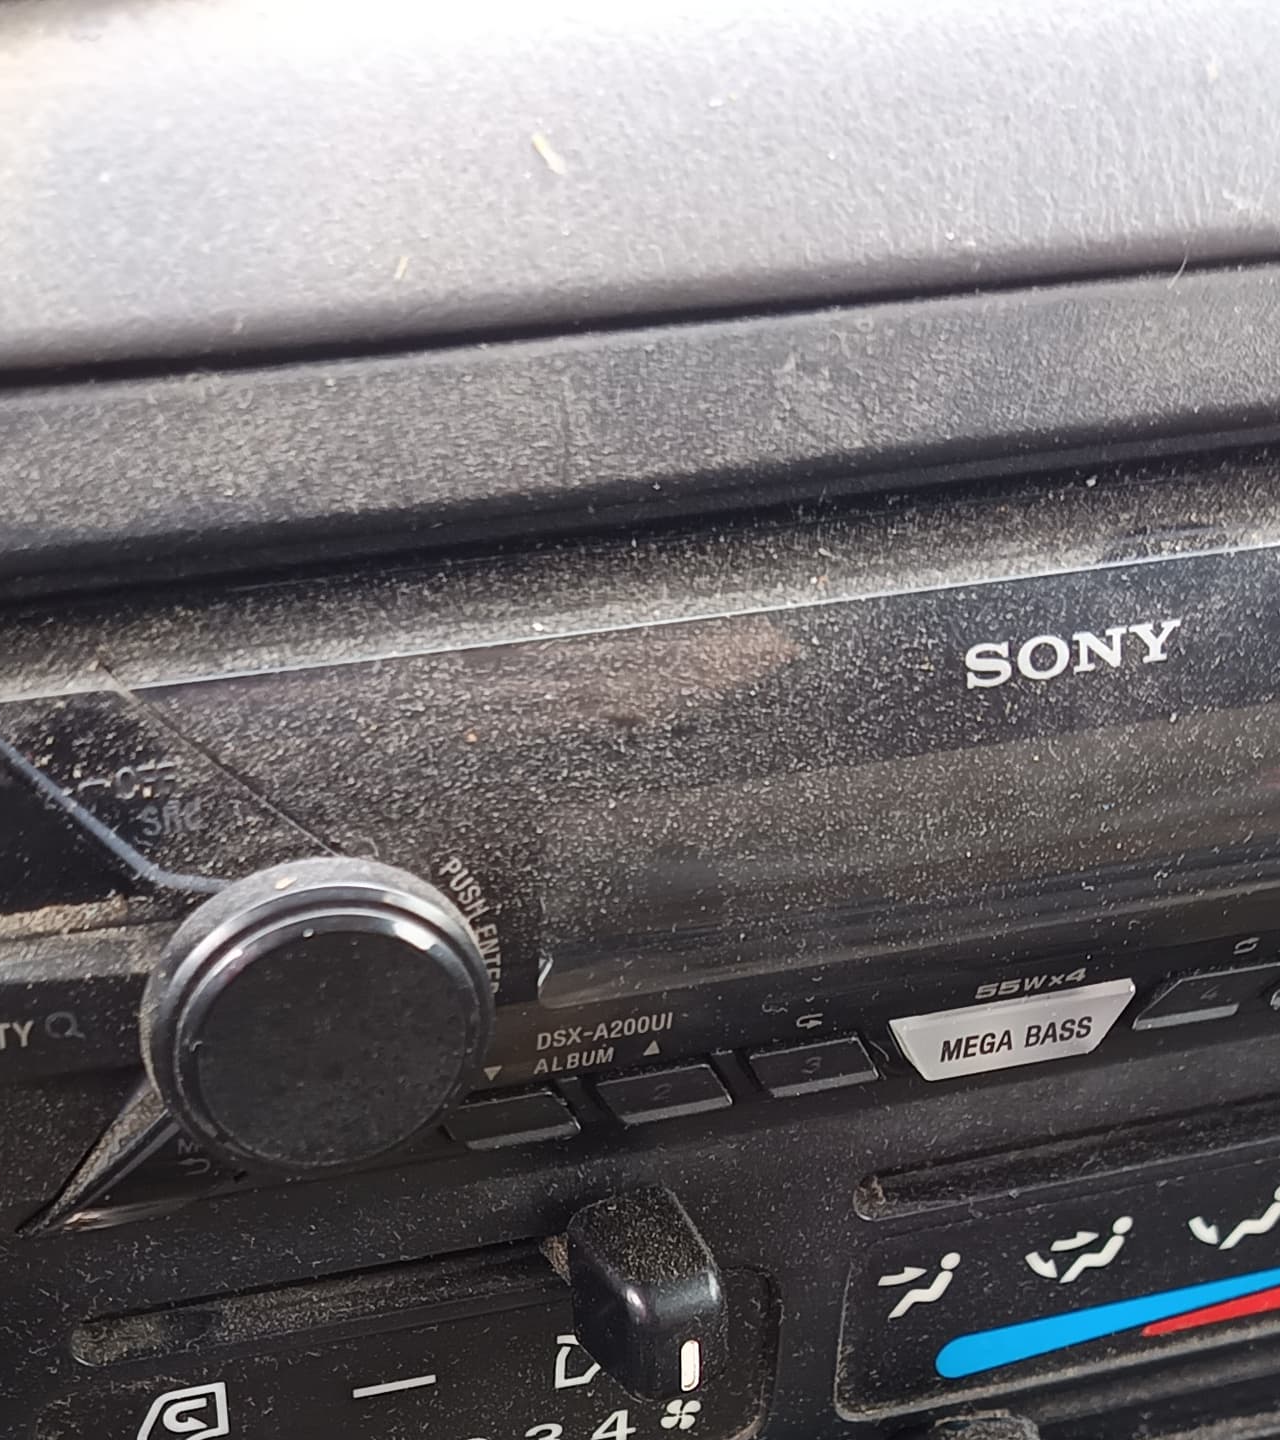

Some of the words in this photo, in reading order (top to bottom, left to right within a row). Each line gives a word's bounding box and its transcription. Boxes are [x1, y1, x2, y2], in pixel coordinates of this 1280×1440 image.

[964, 619, 1182, 690] SONY
[438, 855, 491, 922] PUSH
[536, 1011, 673, 1051] DSX-A200UI
[939, 1029, 1014, 1063] MEGA
[1023, 1015, 1094, 1049] BASS
[533, 1046, 615, 1075] ALBUM
